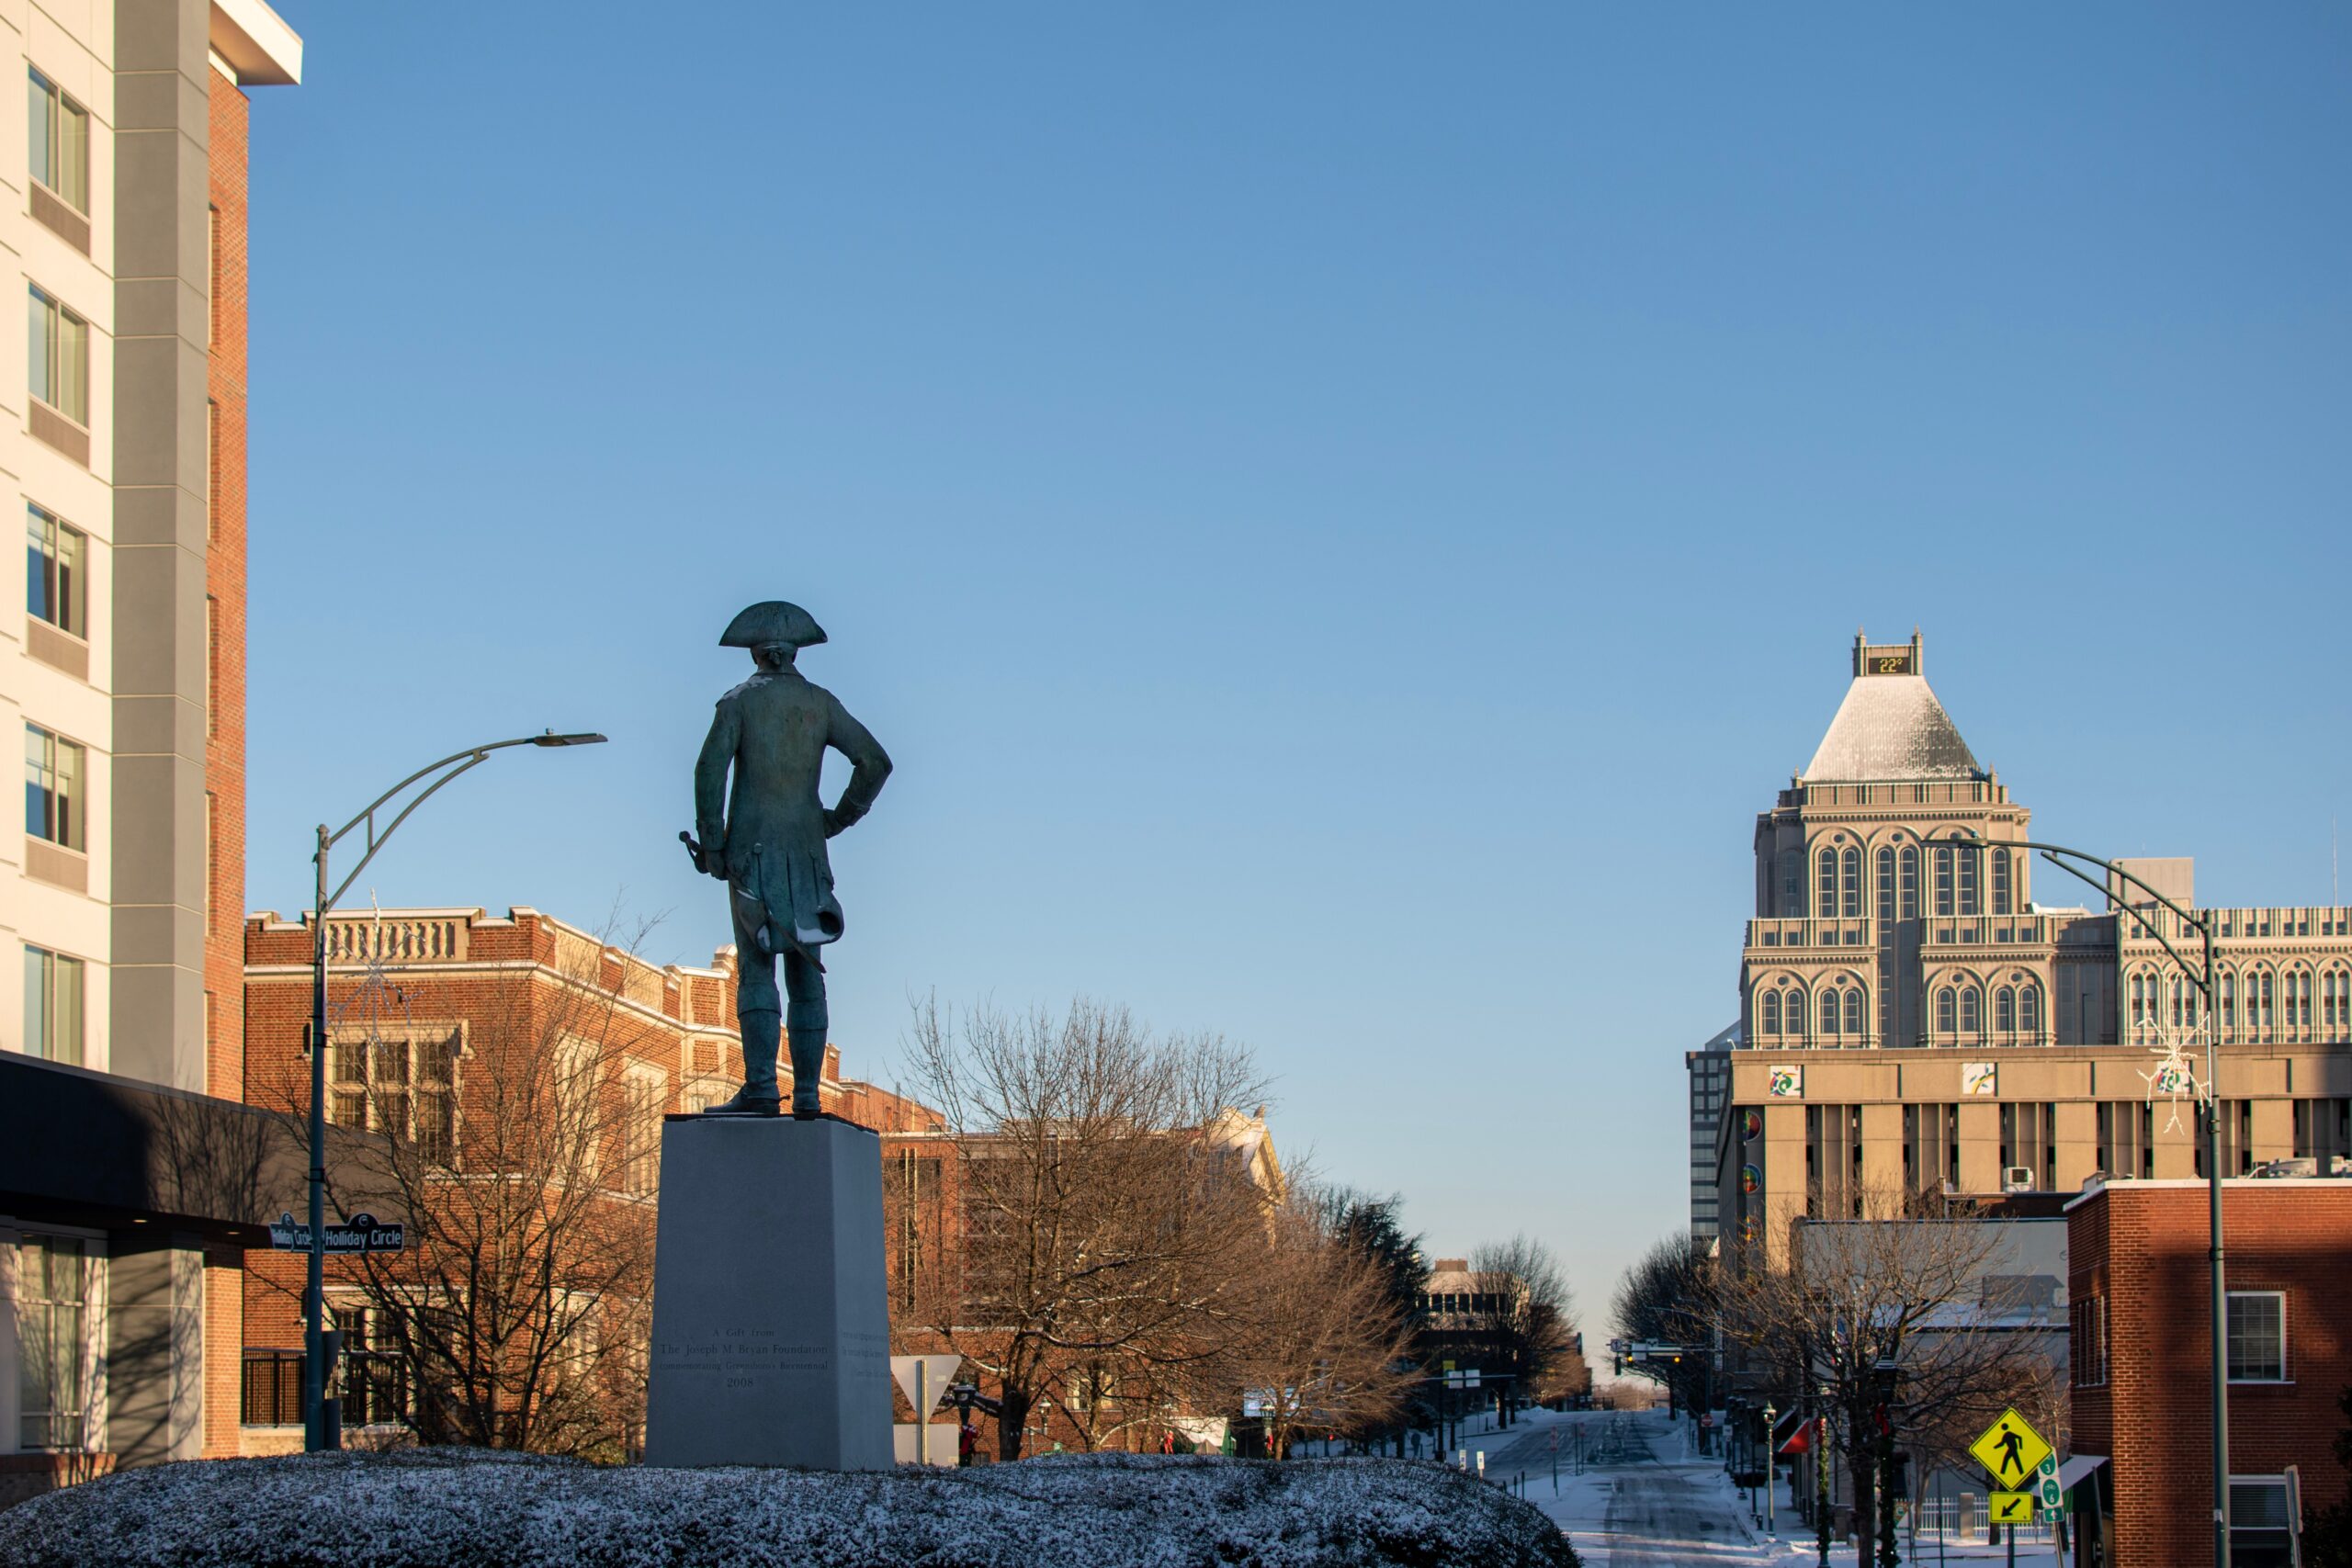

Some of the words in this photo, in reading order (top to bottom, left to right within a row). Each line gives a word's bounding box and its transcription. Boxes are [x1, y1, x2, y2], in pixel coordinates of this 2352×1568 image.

[325, 1230, 367, 1249] Holliday
[371, 1229, 401, 1246] Circle
[726, 1329, 744, 1337] Gift
[752, 1329, 775, 1337] from
[661, 1344, 680, 1354] The
[685, 1344, 718, 1357] Joseph
[739, 1344, 768, 1355] Bryan
[773, 1344, 829, 1354] Foundation
[661, 1362, 721, 1372] commemorating
[780, 1360, 829, 1370] Bicentennial
[727, 1377, 753, 1388] 2008
[2044, 1464, 2051, 1473] 3
[2050, 1494, 2054, 1503] 6
